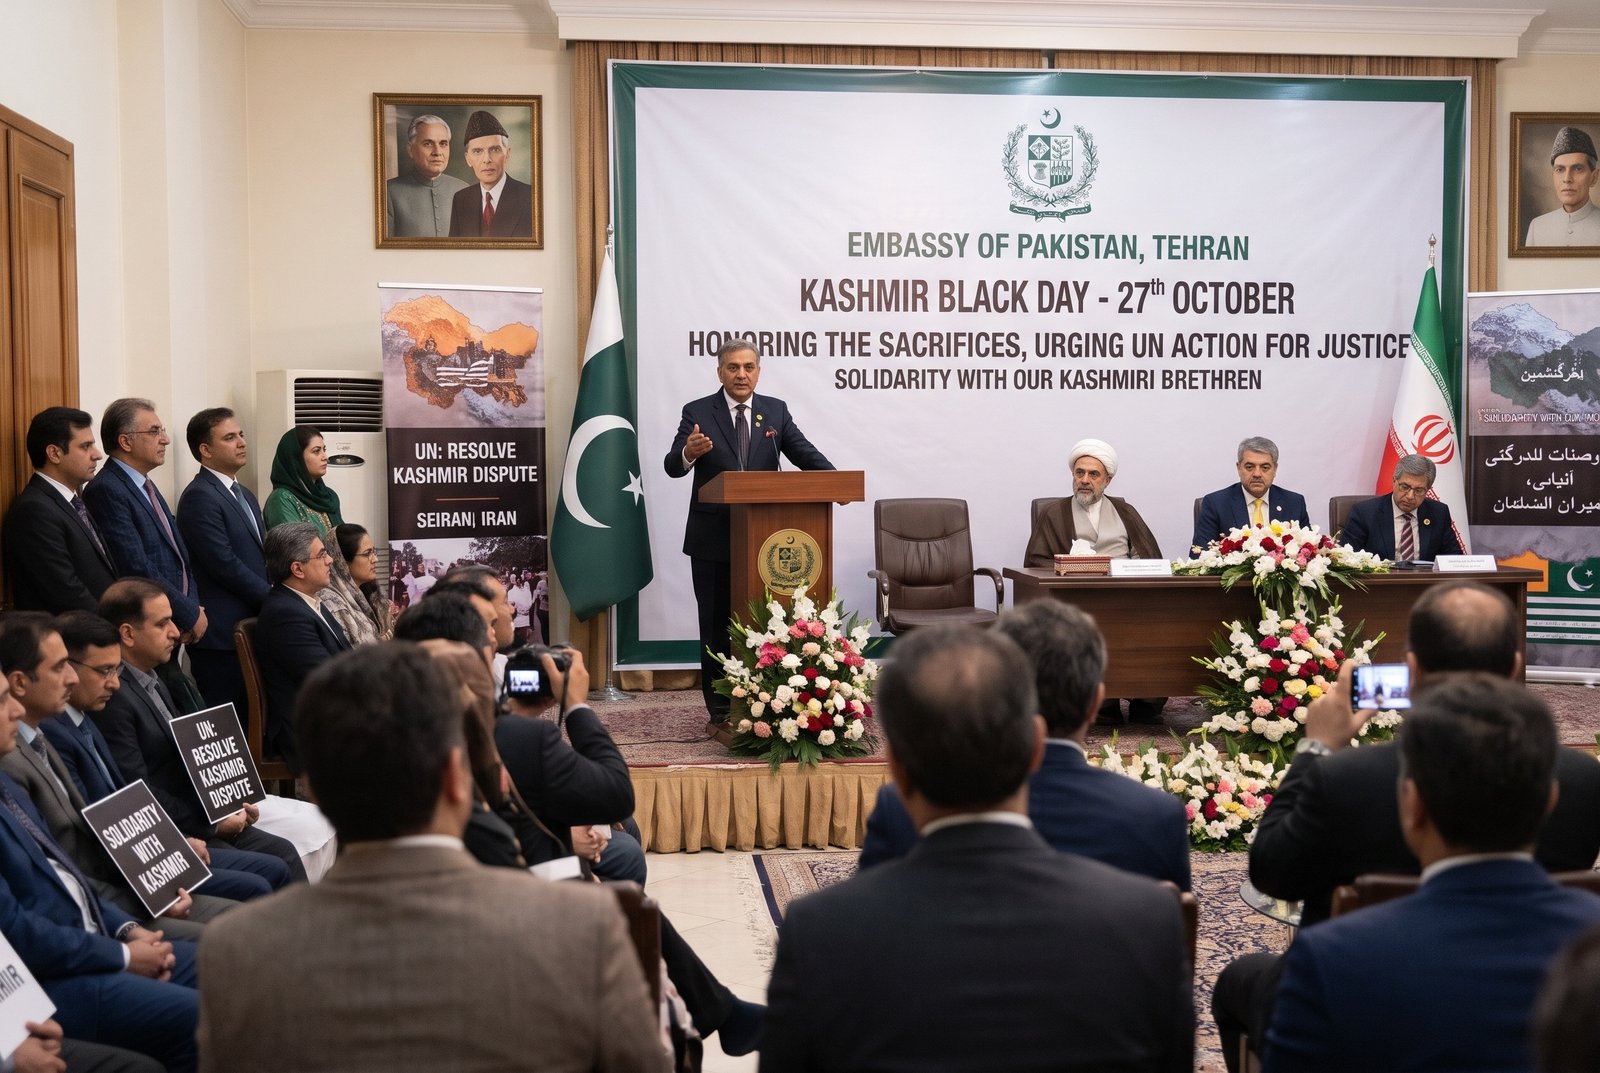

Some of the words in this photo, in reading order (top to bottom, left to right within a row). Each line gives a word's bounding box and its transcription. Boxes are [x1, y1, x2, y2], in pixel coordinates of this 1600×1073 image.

[848, 231, 970, 259] EMBASSY
[977, 232, 1010, 260] OF
[1017, 233, 1145, 265] PAKISTAN,
[1152, 234, 1249, 261] TEHRAN
[800, 278, 929, 313] KASHMIR
[938, 279, 1029, 314] BLACK
[1037, 280, 1090, 314] DAY
[1117, 277, 1165, 314] 27th
[1172, 280, 1295, 315] OCTOBER
[824, 331, 872, 358] THE
[878, 331, 1027, 364] SACRIFICES,
[1035, 331, 1124, 359] URGING
[1132, 332, 1164, 359] UN
[1170, 332, 1258, 359] ACTION
[1265, 332, 1310, 359] FOR
[1317, 333, 1411, 360] JUSTICE
[834, 368, 952, 390] SOLIDARITY
[956, 368, 1007, 390] WITH
[1013, 368, 1053, 390] OUR
[1060, 369, 1155, 390] KASHMIRI
[1161, 369, 1262, 390] BRETHREN
[415, 442, 443, 460] UN:
[447, 441, 517, 460] RESOLVE
[393, 466, 468, 485] KASHMIR
[472, 465, 538, 484] DISPUTE
[481, 510, 517, 527] IRAN
[196, 720, 218, 740] UN:
[192, 737, 239, 766] RESOLVE
[199, 757, 247, 787] KASHMIR
[209, 779, 254, 809] DISPUTE
[102, 803, 161, 850] SOLIDARITY
[132, 834, 165, 864] WITH
[138, 851, 190, 895] KASHMIR
